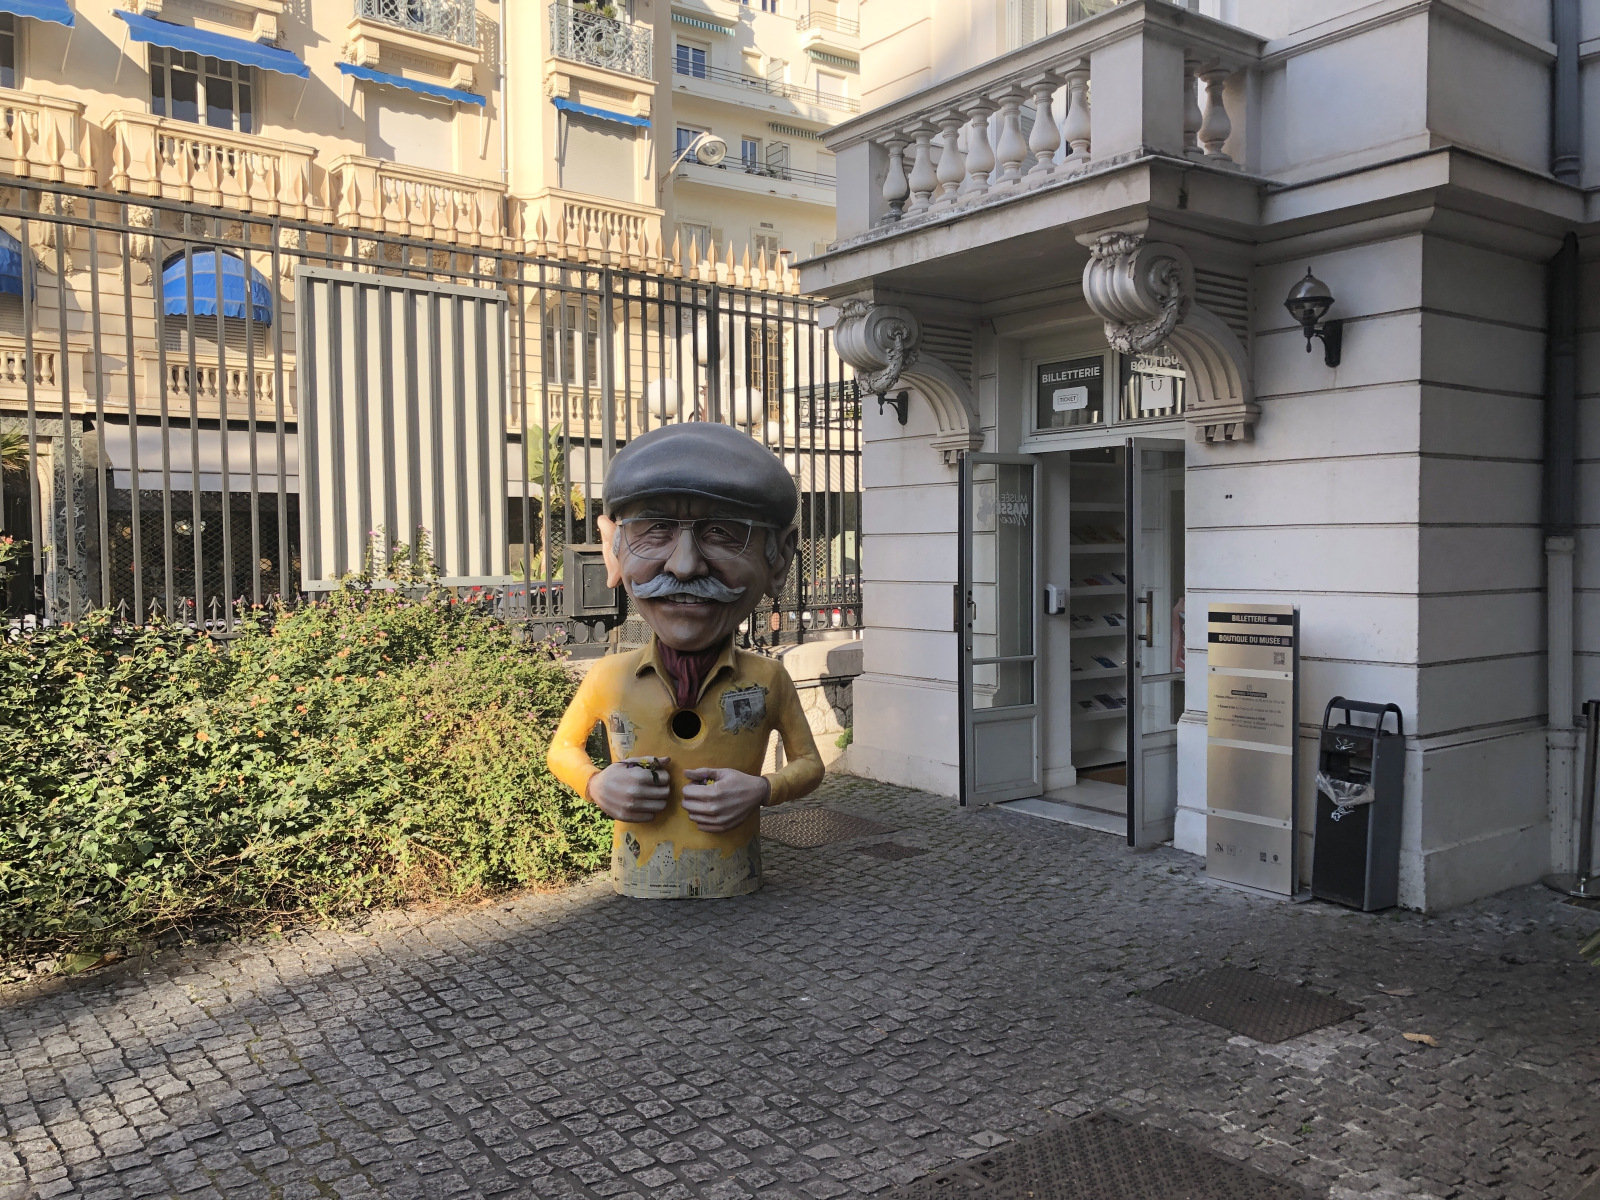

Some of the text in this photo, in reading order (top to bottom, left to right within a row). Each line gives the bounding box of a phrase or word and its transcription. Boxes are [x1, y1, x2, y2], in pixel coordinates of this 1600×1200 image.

[1131, 356, 1181, 371] BOUTIQU
[1042, 366, 1100, 383] BILLETTERIE
[1231, 614, 1267, 622] BILLETTERIE
[1219, 635, 1248, 643] BOUTIQUE
[1259, 635, 1281, 645] MUSÉE
